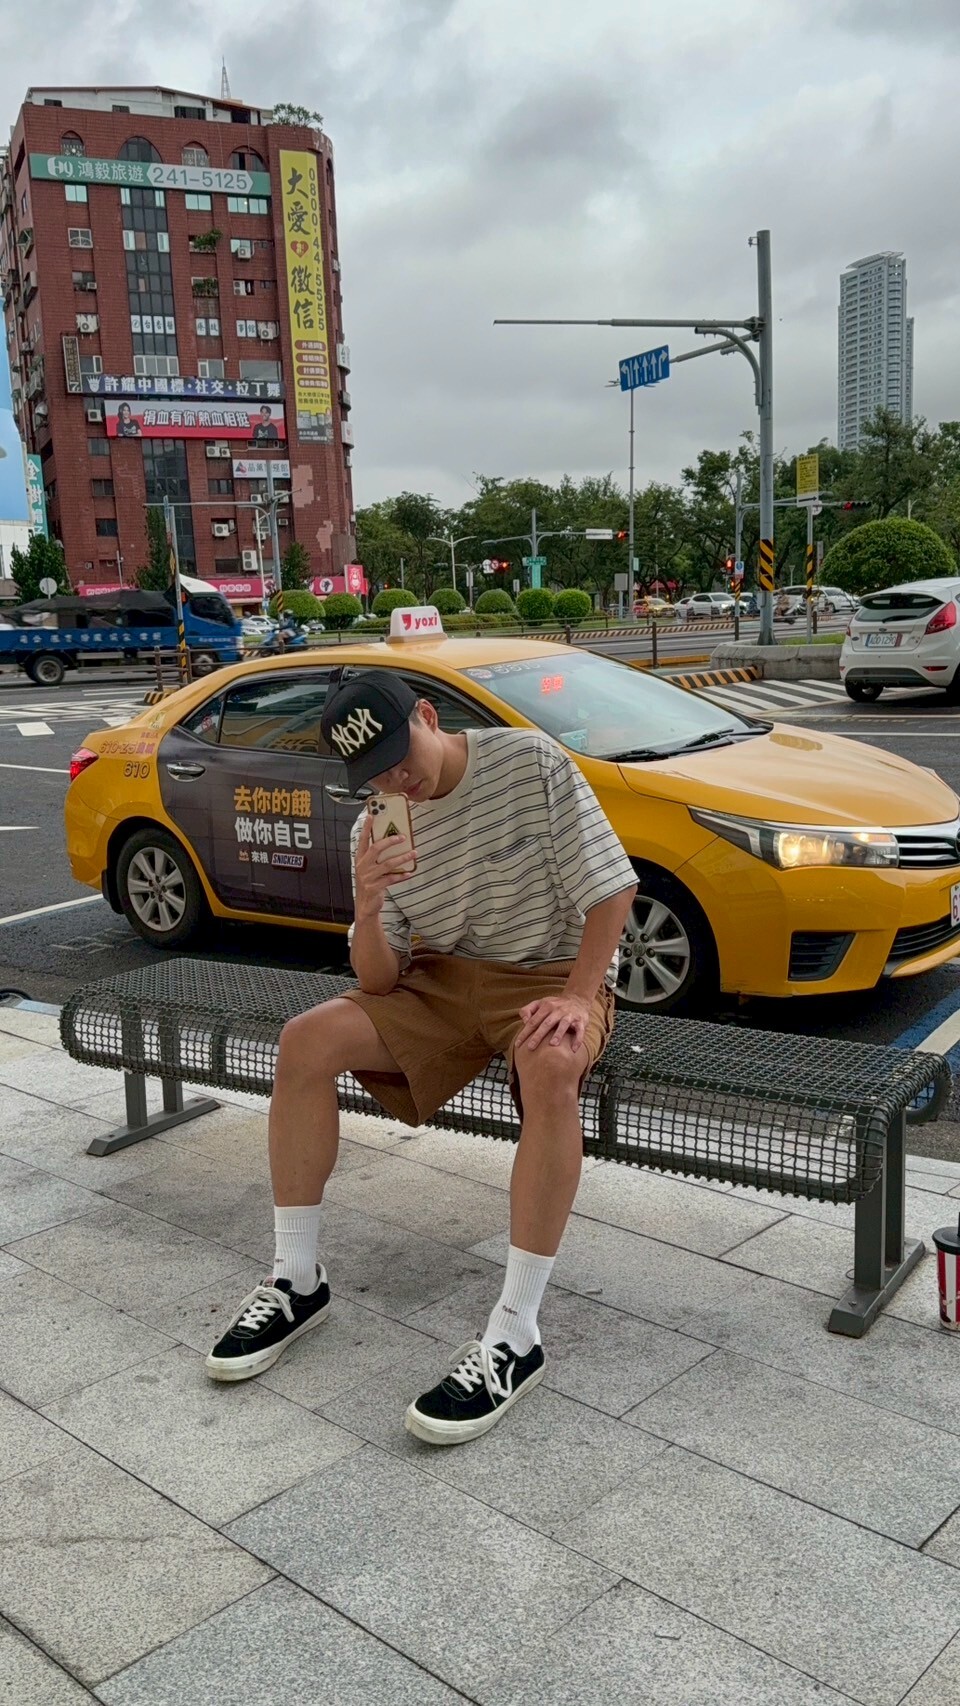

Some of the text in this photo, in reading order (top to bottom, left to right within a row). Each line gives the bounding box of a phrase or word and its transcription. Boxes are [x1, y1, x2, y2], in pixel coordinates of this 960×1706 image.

[77, 160, 145, 183] 鴻毅旅遊
[152, 167, 248, 190] 241-5125
[414, 612, 438, 631] yoxi
[123, 761, 151, 779] 610
[233, 784, 312, 818] 去你的餓
[234, 816, 313, 849] 做你自己
[272, 853, 303, 867] SNICKERS
